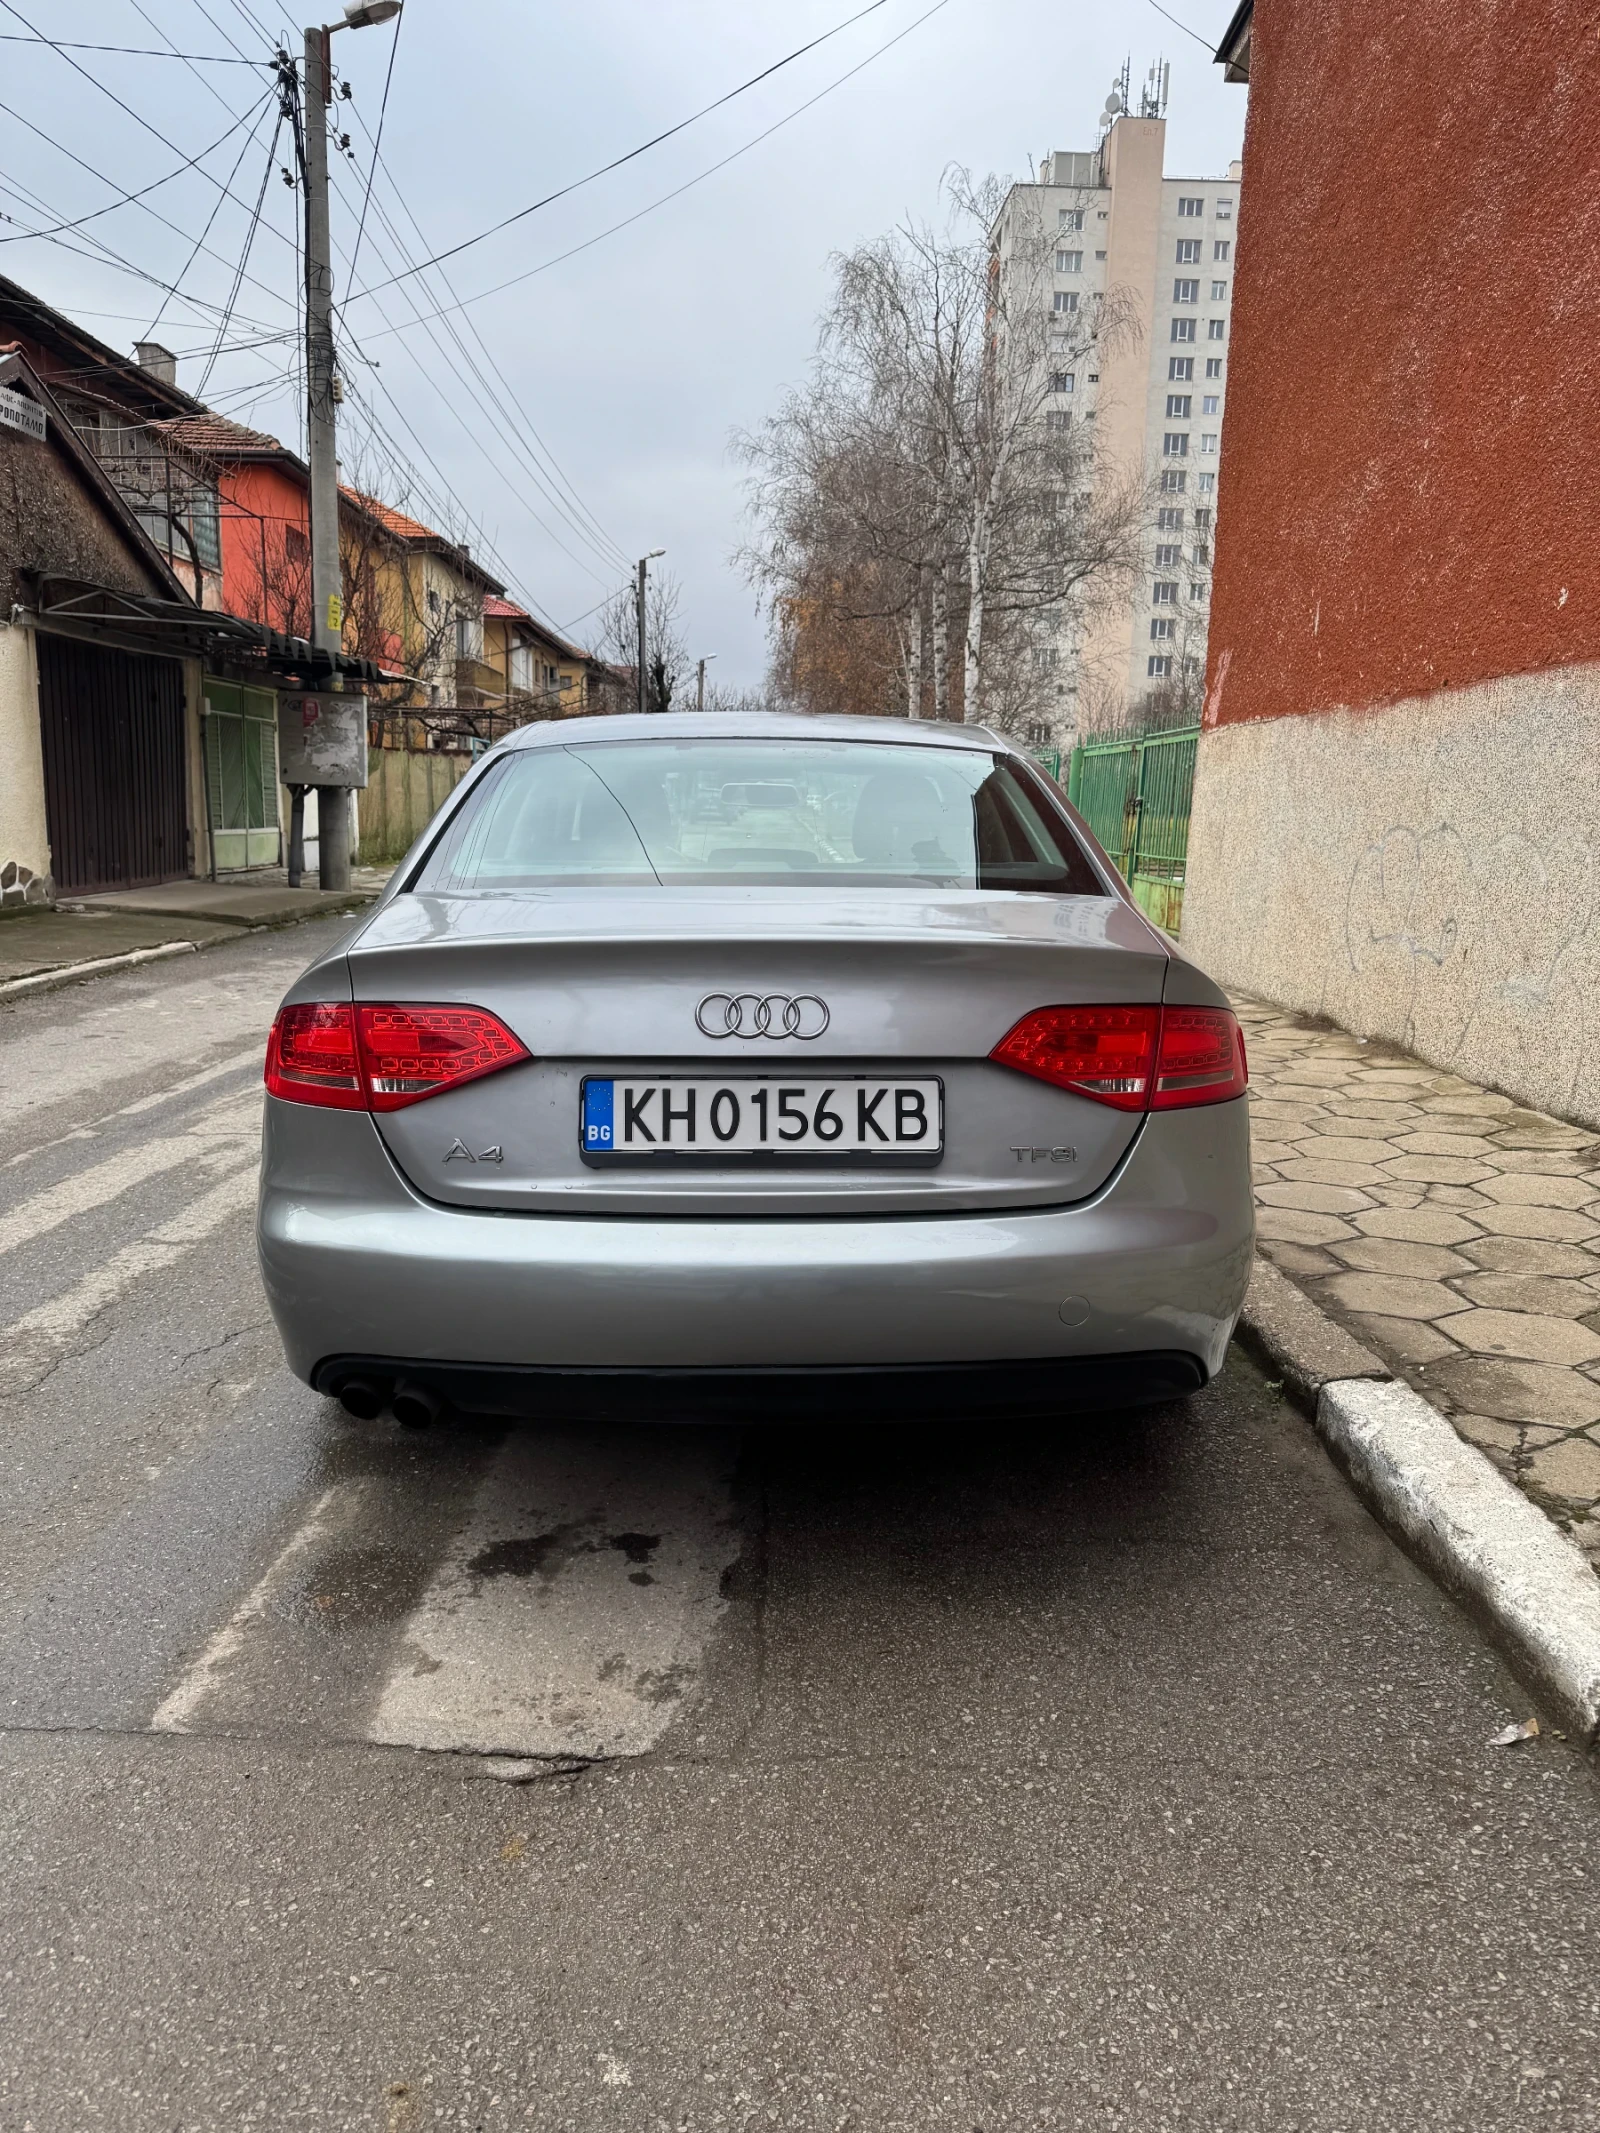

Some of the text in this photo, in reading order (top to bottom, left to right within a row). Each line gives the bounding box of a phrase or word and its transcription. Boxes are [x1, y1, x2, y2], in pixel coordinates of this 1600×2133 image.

[0, 392, 44, 418] АФЕ-АПЕРИТИВ
[587, 1125, 611, 1141] BG
[441, 1137, 504, 1164] A4
[1009, 1146, 1078, 1163] TFSI
